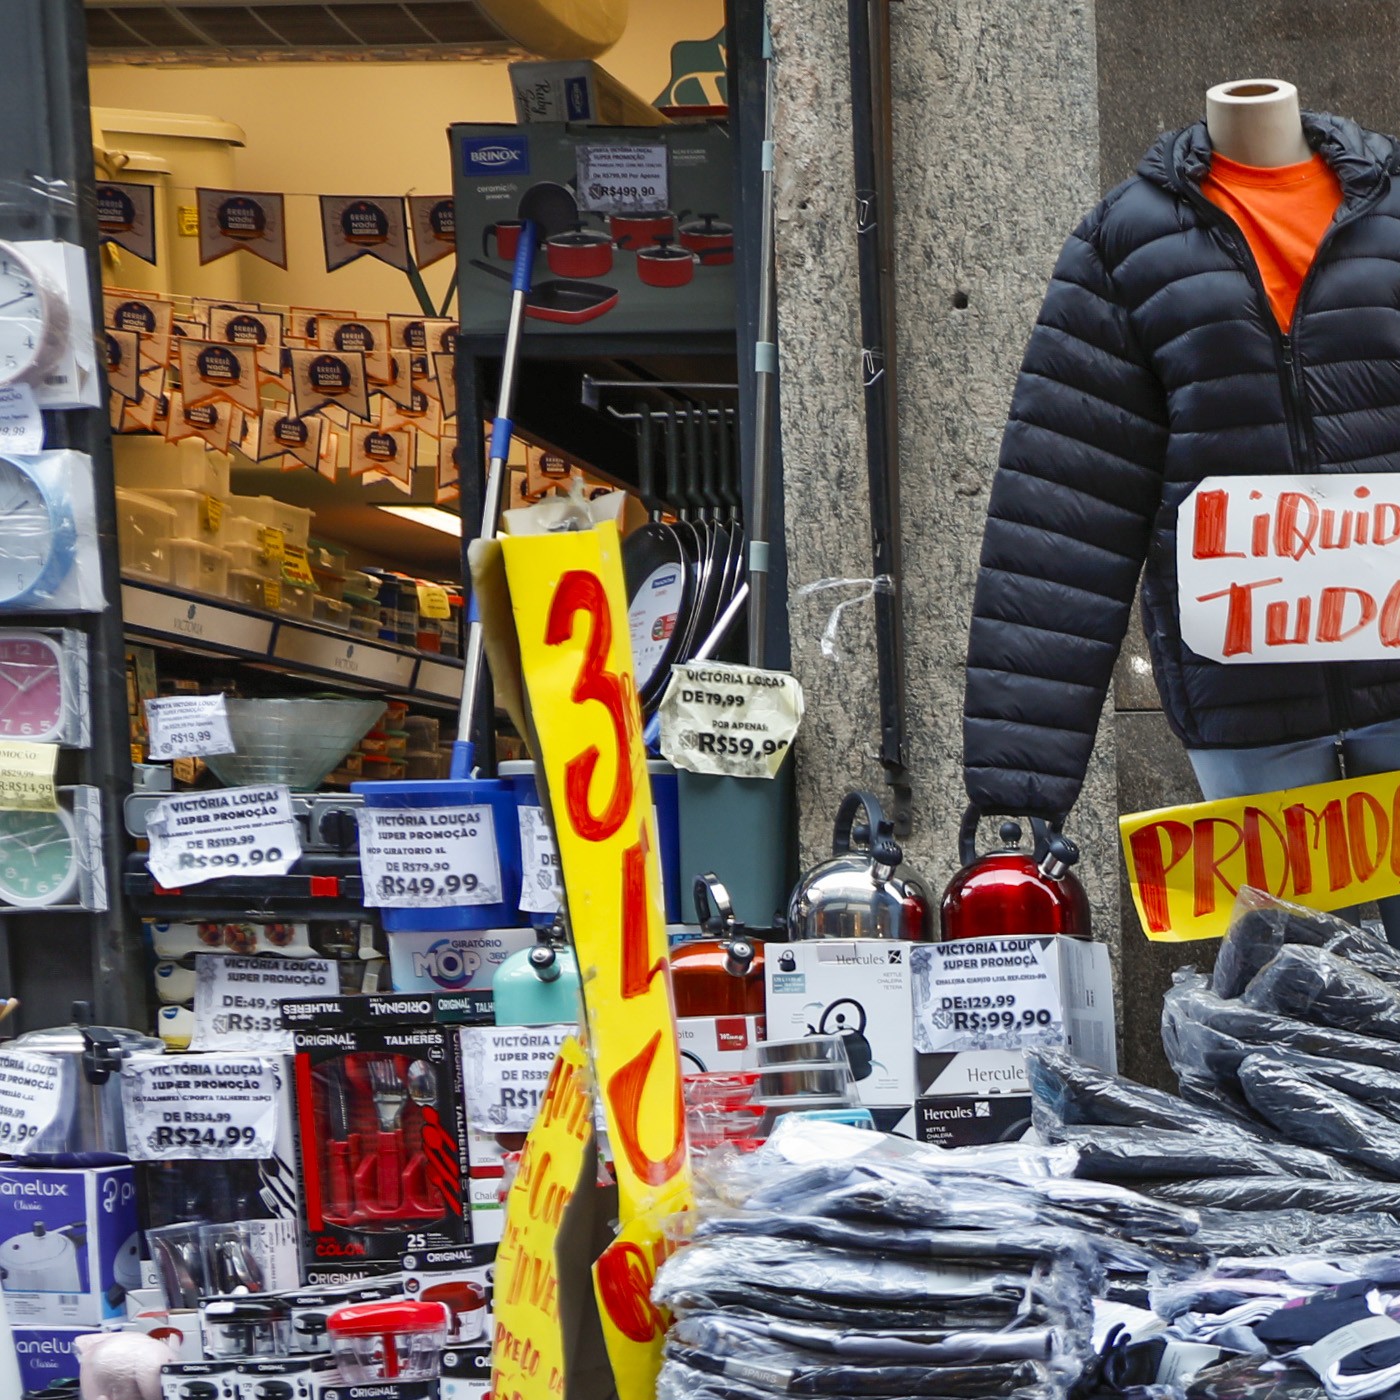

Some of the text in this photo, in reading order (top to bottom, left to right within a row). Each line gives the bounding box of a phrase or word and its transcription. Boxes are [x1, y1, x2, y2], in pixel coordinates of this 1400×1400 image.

[470, 149, 520, 162] BRINOX
[682, 690, 745, 708] DE 79,99
[170, 731, 211, 743] R$19,99
[171, 790, 279, 813] VICTÓRIA LOUÇAS
[176, 806, 277, 826] SUPER PROMOÇÃO
[375, 812, 481, 826] VICTÓRIA LOUÇAS
[378, 828, 478, 840] SUPER PROMOÇÃO
[186, 839, 205, 850] DE
[178, 847, 283, 870] R$99,90
[386, 861, 400, 872] DE
[381, 873, 479, 896] R$49,99
[451, 937, 502, 949] GIRATÓRIO
[224, 959, 329, 973] VICTÓRIA LOUÇAS
[412, 948, 481, 984] MOP
[835, 954, 885, 966] Hercules
[943, 959, 978, 971] SUPER
[227, 972, 326, 986] SUPER PROMOÇÃO
[941, 995, 1015, 1011] DE:129,99
[954, 1009, 1051, 1033] R$:99,90
[295, 1032, 443, 1046] ORIGINAL TALHERES
[492, 1035, 550, 1047] VICTÓRIA
[494, 1052, 528, 1062] SUPER
[215, 1064, 263, 1078] LOUÇAS
[501, 1070, 519, 1080] DE
[967, 1065, 1025, 1083] Hercule
[152, 1078, 260, 1091] SUPER PROMOÇÃO
[163, 1112, 182, 1123] DE
[923, 1107, 973, 1121] Hercules
[155, 1125, 256, 1148] R$24,99
[455, 1105, 468, 1174] TALHERES
[407, 1233, 426, 1248] 25
[427, 1250, 472, 1262] ORIGINAL
[349, 1386, 399, 1398] ORIGINAL
